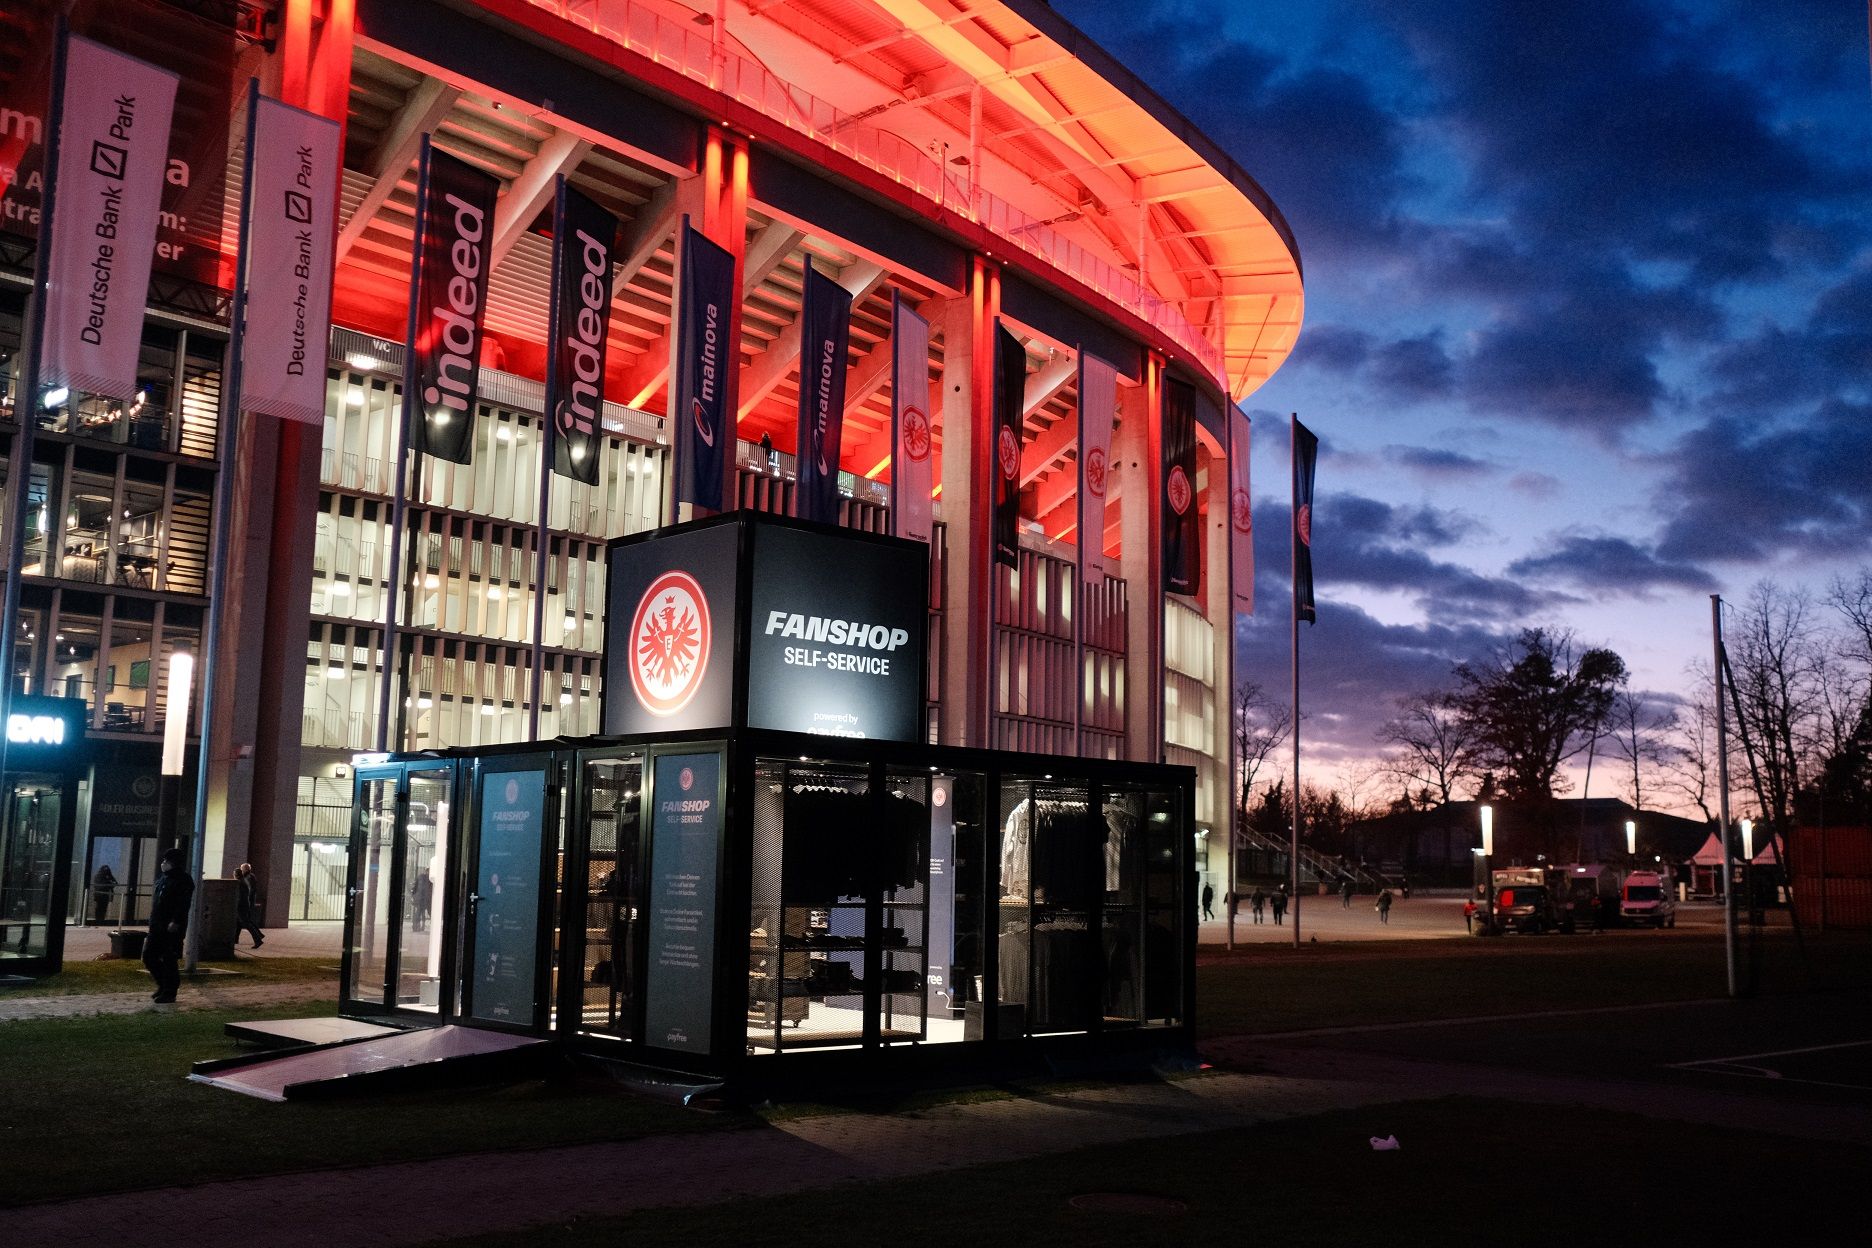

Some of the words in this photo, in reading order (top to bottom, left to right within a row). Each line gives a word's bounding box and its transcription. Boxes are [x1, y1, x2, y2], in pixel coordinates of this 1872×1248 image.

[109, 94, 136, 141] Park
[297, 145, 312, 190] Park
[96, 185, 123, 239] Bank
[295, 230, 312, 280] Bank
[80, 243, 114, 345] Deutsche
[424, 193, 485, 411] indeed
[286, 283, 308, 376] Deutsche
[372, 339, 391, 353] WC
[560, 229, 607, 436] indeed
[700, 303, 718, 402] mainova
[818, 339, 835, 434] mainova
[765, 610, 908, 652] FANSHOP
[784, 647, 890, 676] SELF-SERVICE
[814, 712, 848, 723] powered
[848, 713, 859, 725] by
[492, 811, 530, 822] FANSHOP
[661, 800, 710, 812] FANSHOP
[666, 815, 703, 824] SELF-SERVICE
